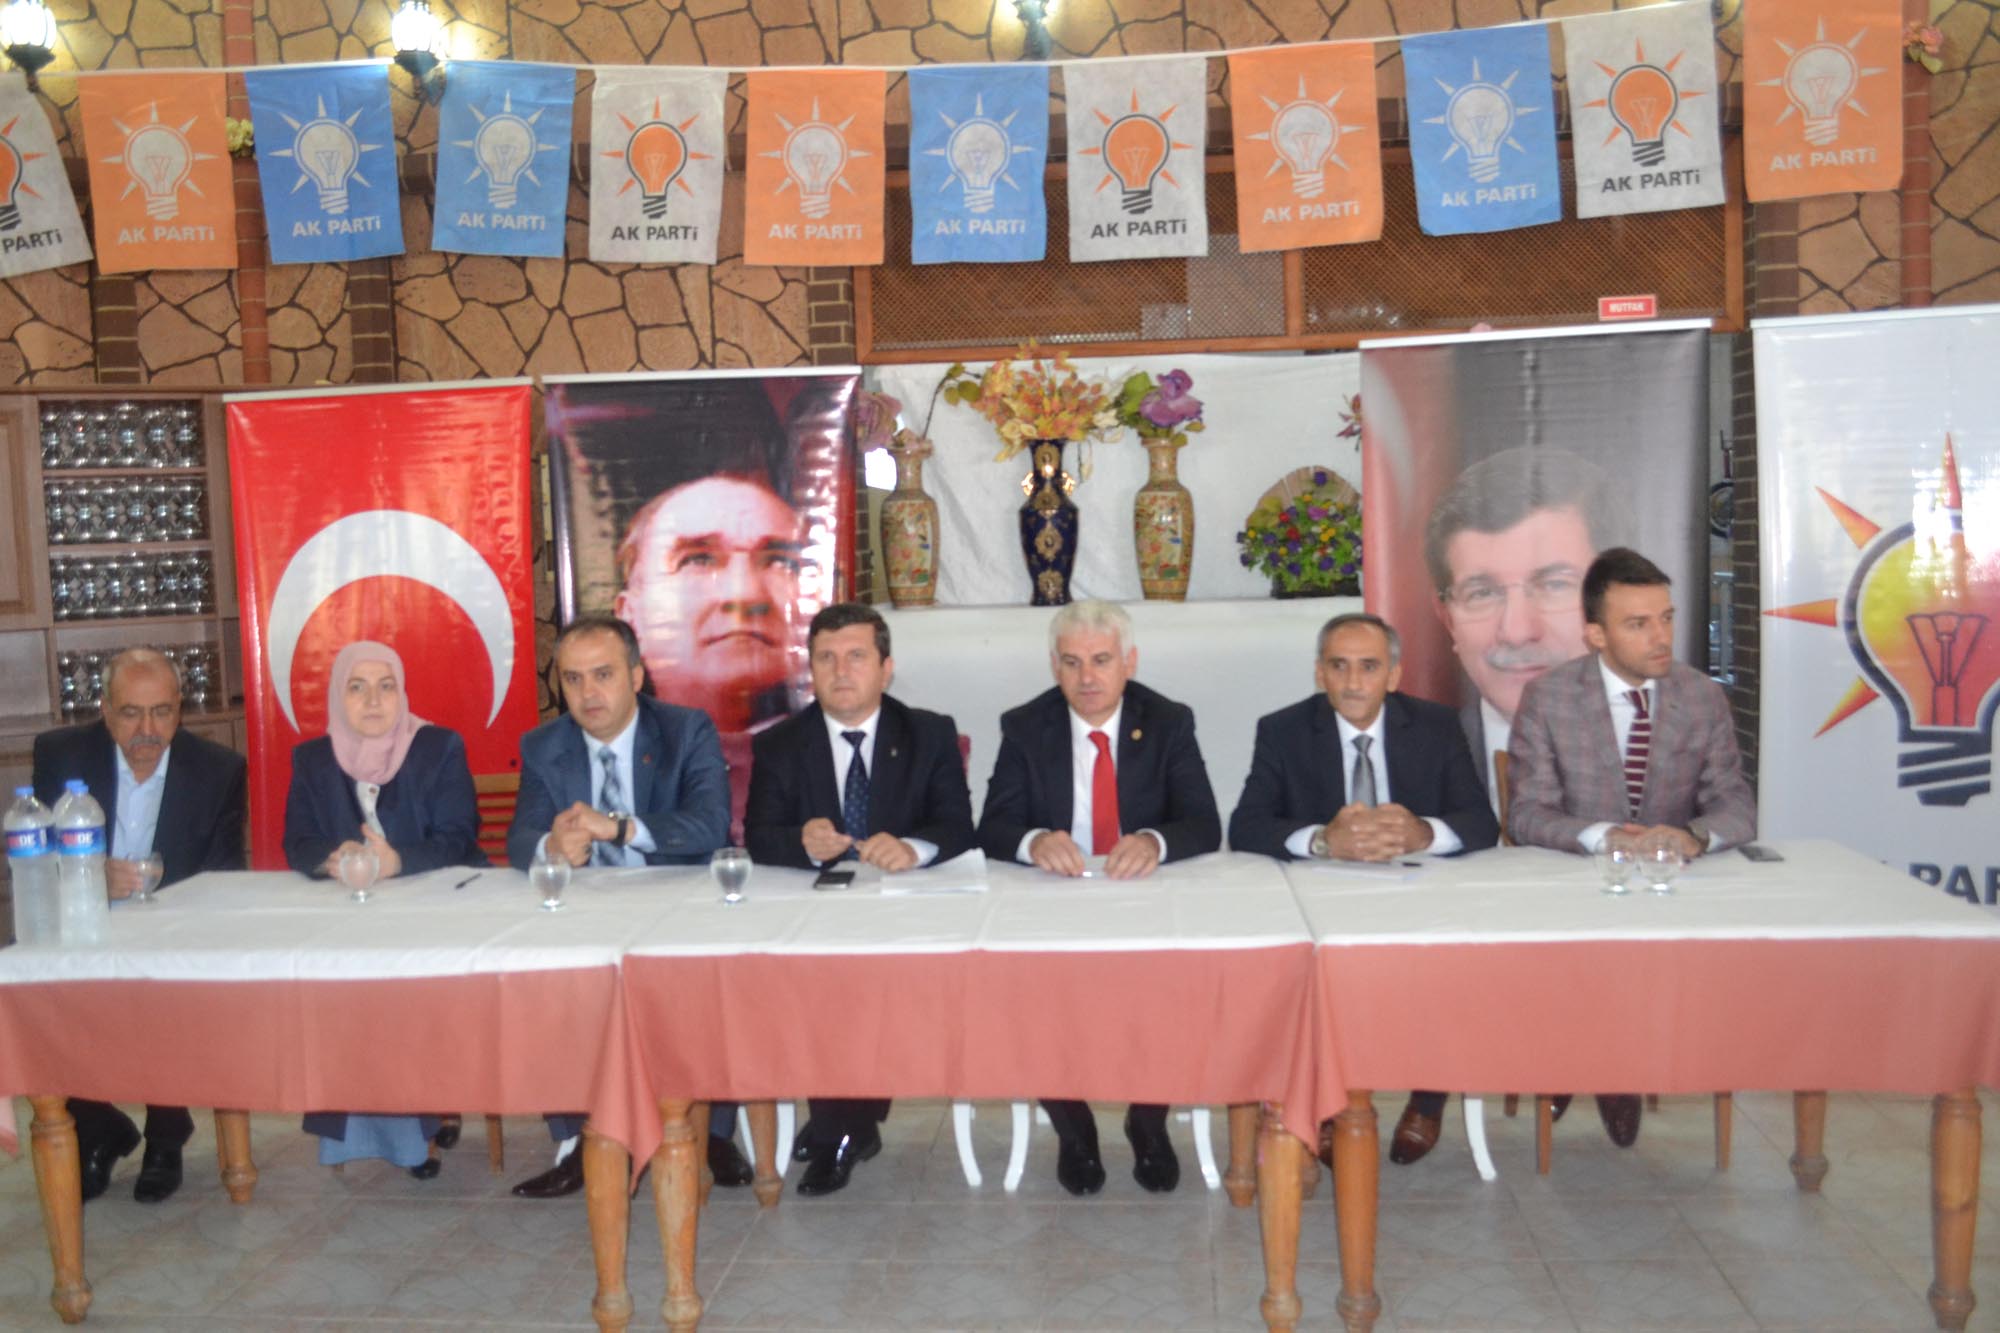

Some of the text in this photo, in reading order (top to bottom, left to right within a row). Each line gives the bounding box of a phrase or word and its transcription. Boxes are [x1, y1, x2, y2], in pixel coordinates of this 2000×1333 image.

[1770, 153, 1803, 171] AK
[1601, 175, 1632, 193] AK
[1441, 191, 1469, 207] AK
[457, 212, 485, 229] AK
[1262, 206, 1292, 223] AK
[118, 227, 146, 244] AK
[293, 221, 321, 237] AK
[611, 226, 640, 240] AK
[768, 224, 798, 239] AK
[935, 219, 962, 235] AK
[1090, 222, 1119, 239] AK
